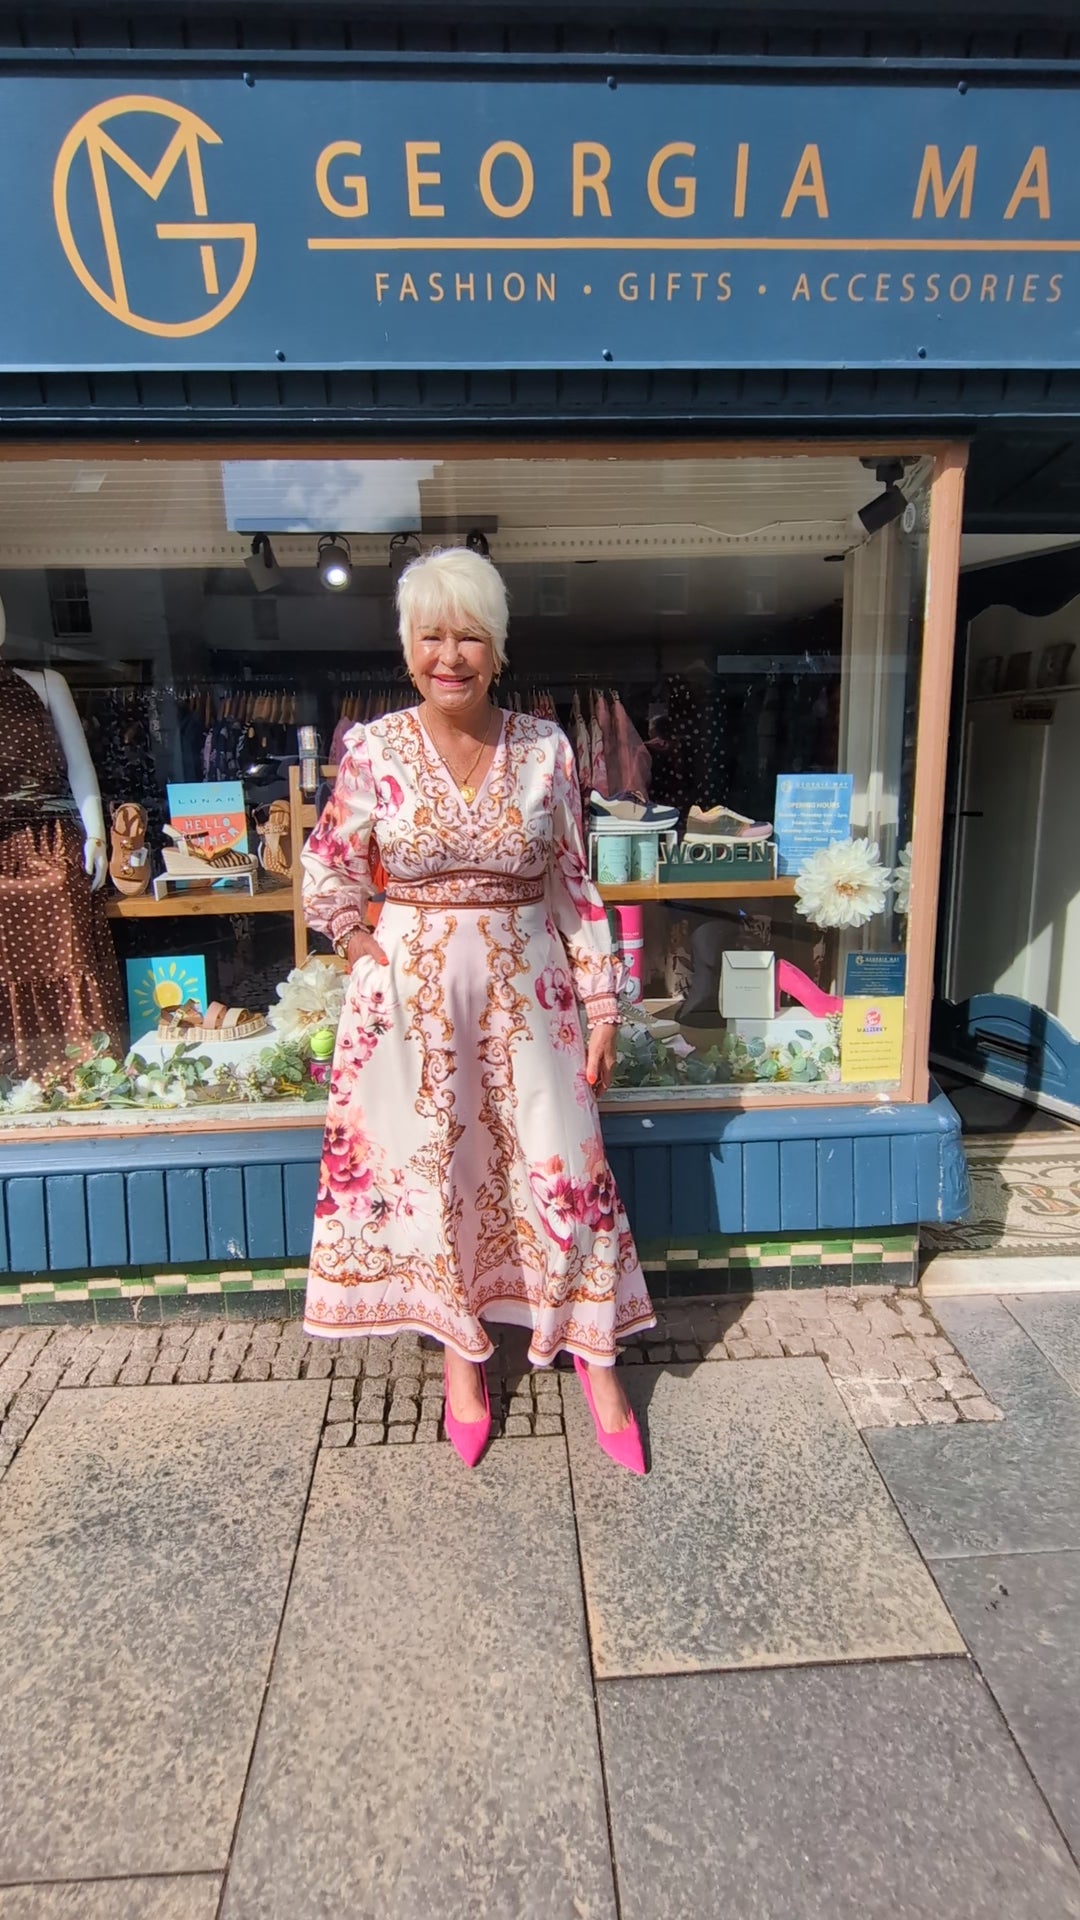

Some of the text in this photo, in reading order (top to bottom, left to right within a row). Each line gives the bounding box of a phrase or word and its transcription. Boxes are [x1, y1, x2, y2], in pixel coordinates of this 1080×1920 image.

[316, 142, 1052, 219] GEORGIA MA
[375, 272, 1064, 303] FASHION GIFTS ACCESSORIES
[178, 797, 235, 805] LUNAR
[185, 817, 231, 830] HELLO
[194, 827, 240, 847] MMER
[659, 840, 770, 865] WODEN
